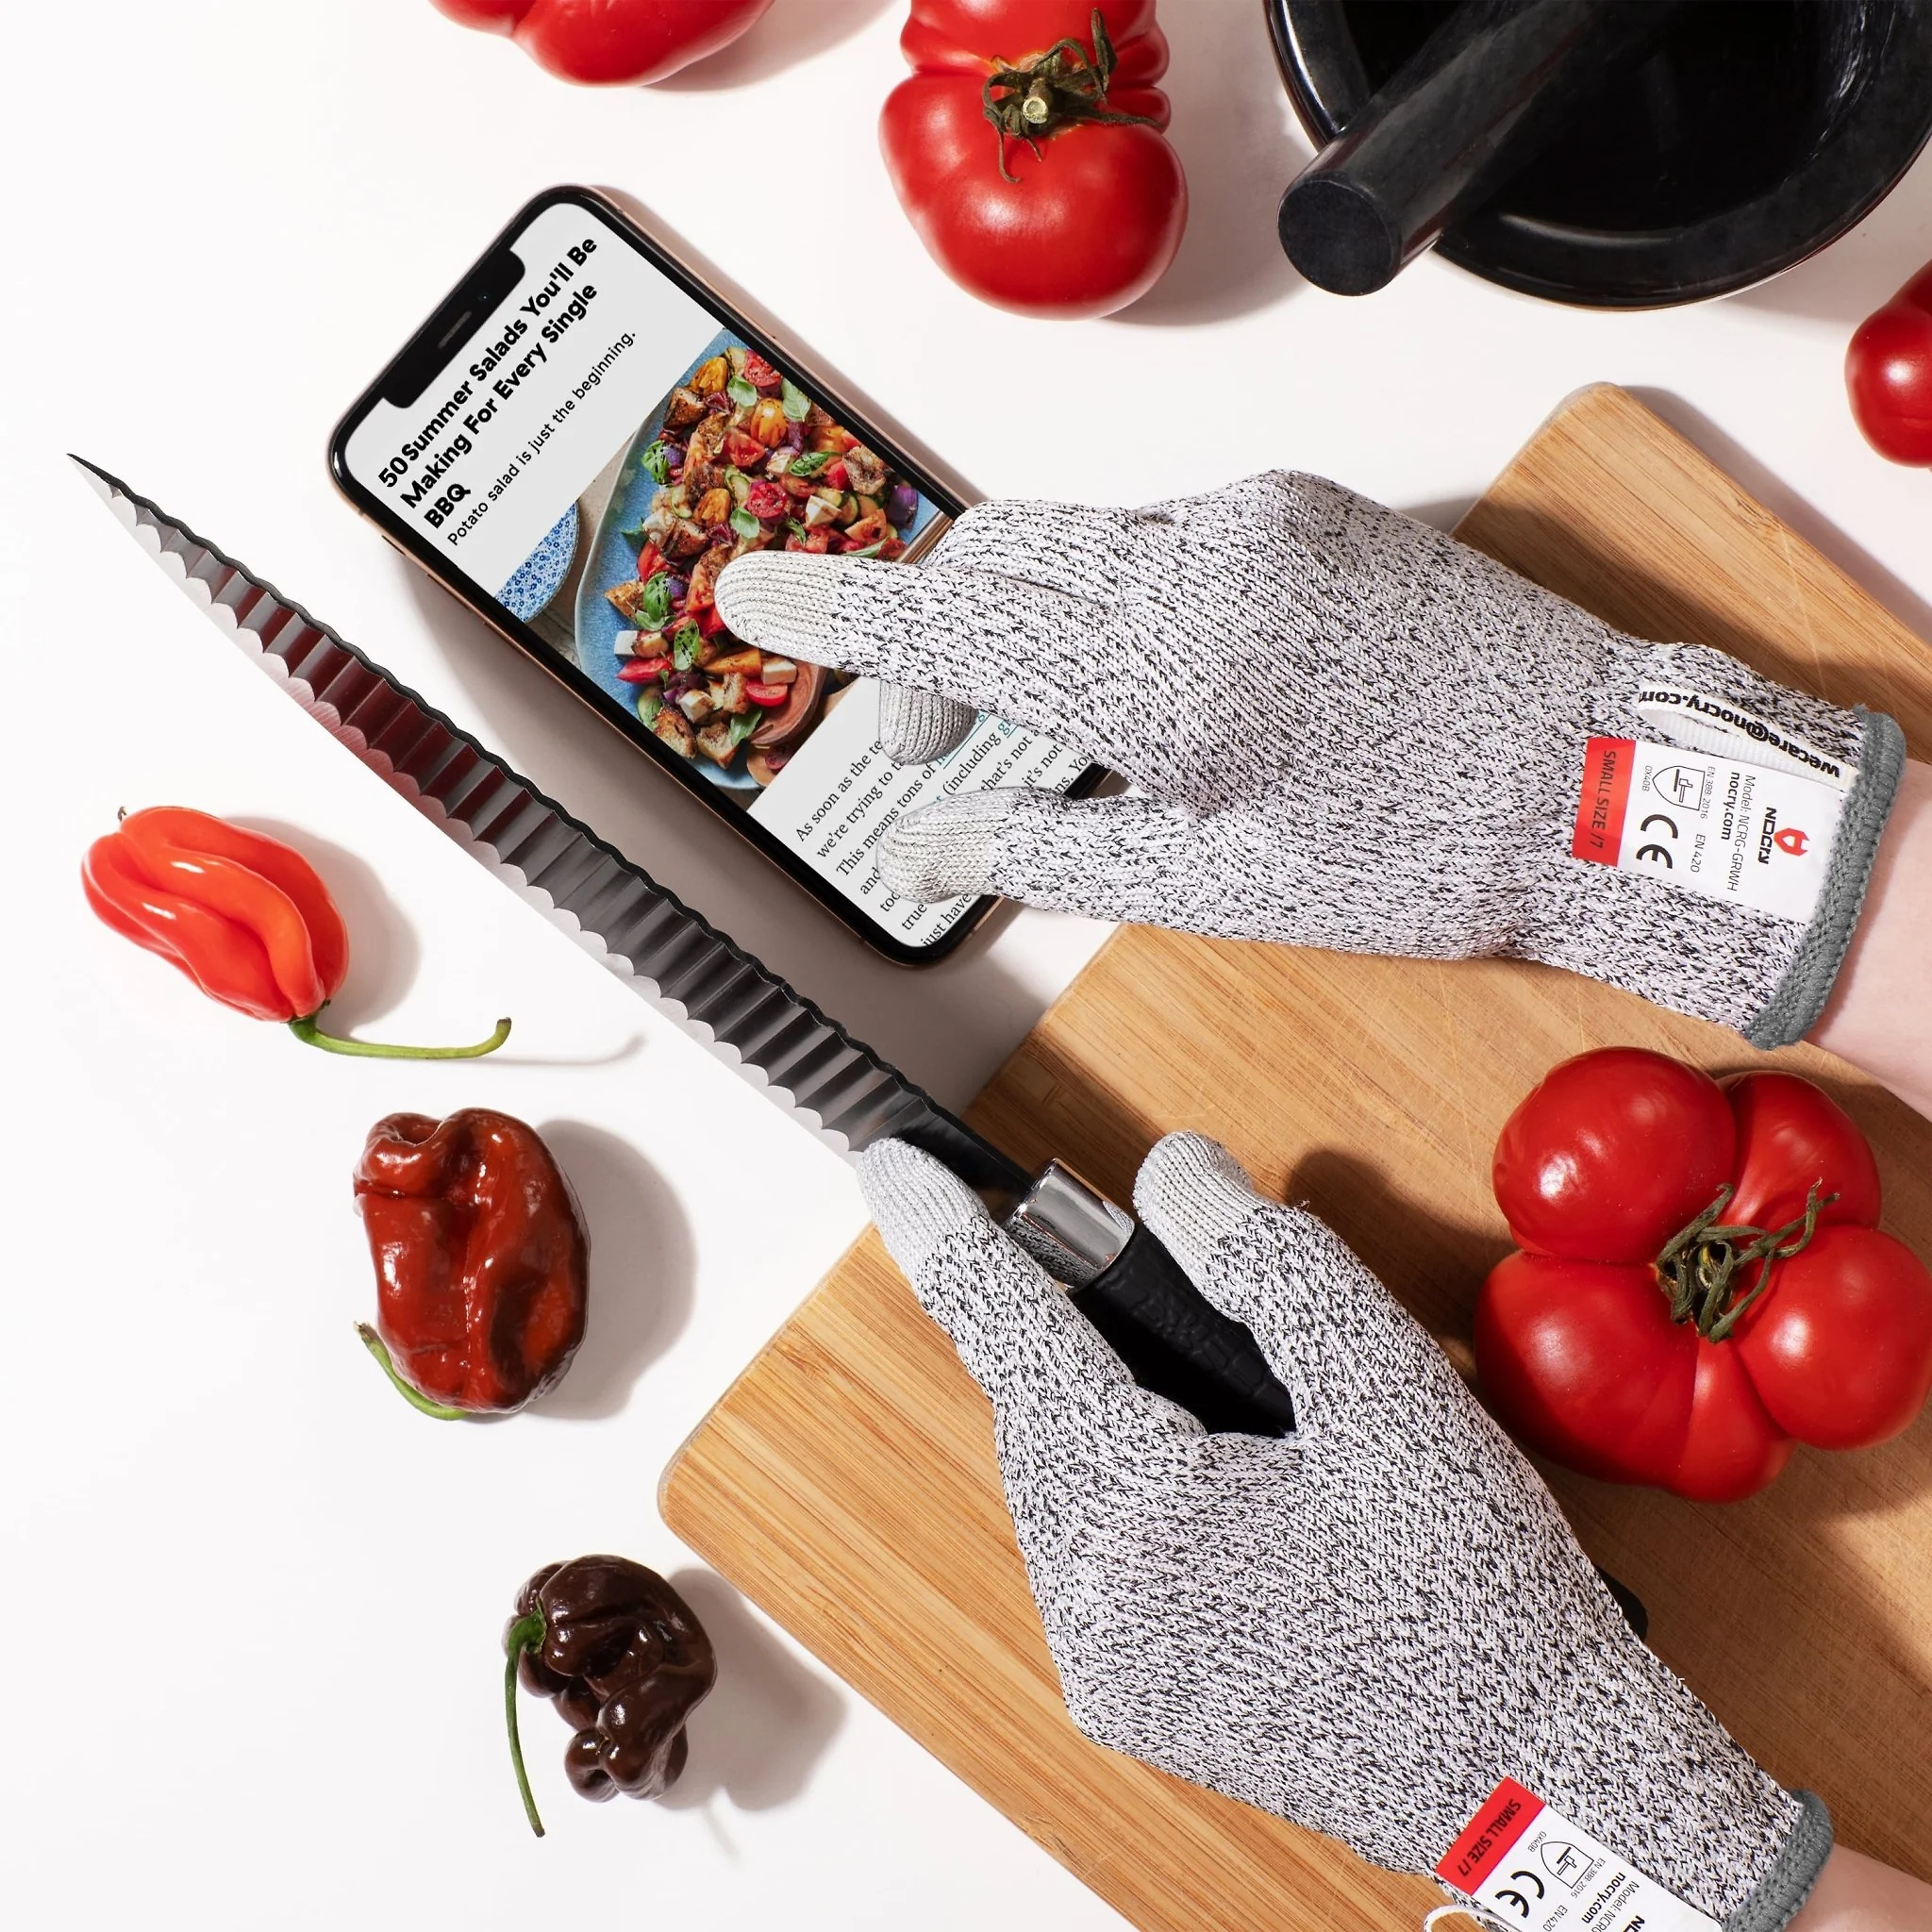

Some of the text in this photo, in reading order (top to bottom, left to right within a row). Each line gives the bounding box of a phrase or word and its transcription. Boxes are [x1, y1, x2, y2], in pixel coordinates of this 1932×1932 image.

[378, 240, 596, 487] 50 Summer Salads You'll Be
[400, 286, 597, 508] Making For Every Single
[448, 334, 635, 545] Potato salad is just the beginning.
[424, 484, 471, 528] BBQ
[1011, 736, 1032, 759] not
[1639, 691, 1840, 777] wecare@nocry.com
[943, 733, 1001, 795] (including
[1598, 751, 1616, 793] SMALL
[1707, 767, 1715, 776] EN
[796, 824, 812, 841] As
[812, 793, 840, 824] soon
[839, 777, 852, 792] as
[851, 756, 871, 776] the
[817, 772, 892, 857] we're trying to
[837, 849, 864, 875] This
[863, 808, 898, 849] means
[897, 780, 923, 808] tons
[923, 761, 936, 779] of
[1592, 798, 1608, 829] SIZE
[1722, 773, 1740, 840] nocry.com
[902, 743, 1063, 929] true it's not
[1690, 834, 1706, 873] EN 420
[1727, 774, 1756, 891] Model: NCRG-GRWH
[941, 893, 972, 924] have
[1486, 1799, 1521, 1837] SMALL
[1467, 1836, 1492, 1863] SIZE
[1591, 1857, 1607, 1870] EN
[1543, 1906, 1567, 1931] EN 420
[1582, 1873, 1625, 1924] nocry.com
[1611, 1880, 1641, 1910] Model:
